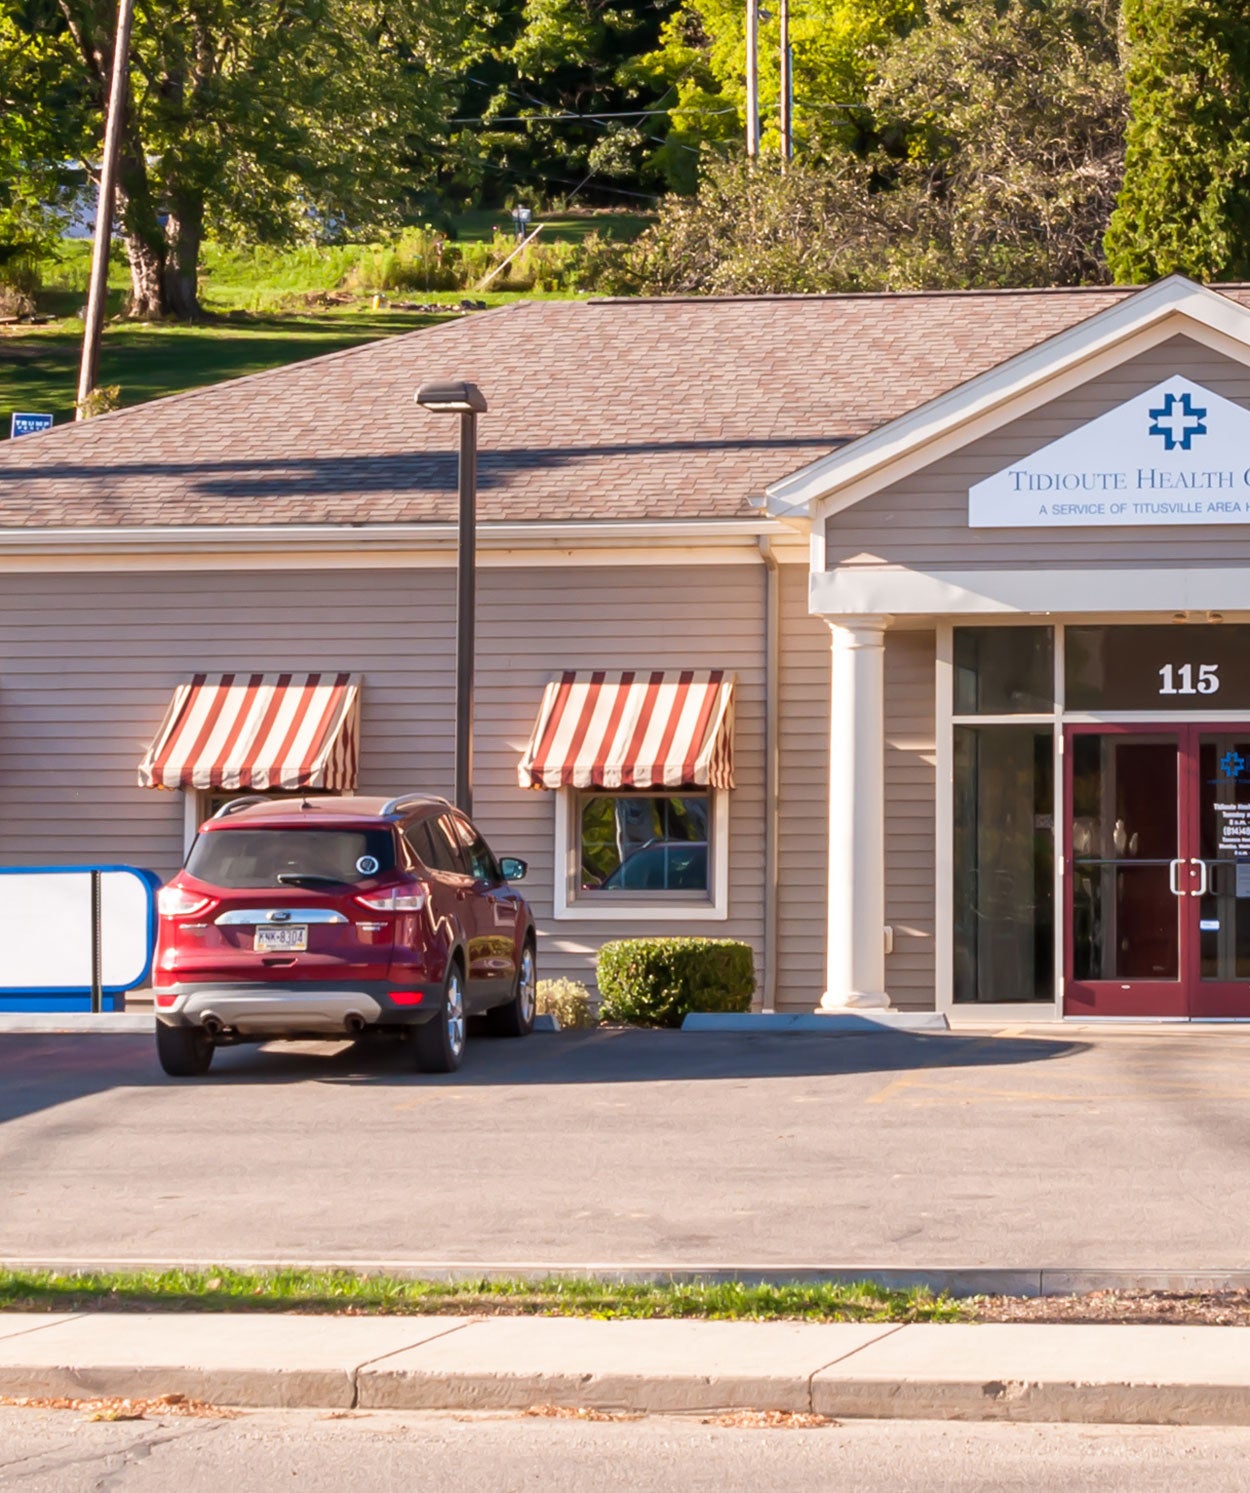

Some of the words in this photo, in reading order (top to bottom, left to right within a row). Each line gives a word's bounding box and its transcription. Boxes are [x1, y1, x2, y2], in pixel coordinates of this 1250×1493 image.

[1008, 470, 1127, 491] TIDIOUTE
[1136, 468, 1234, 490] HEALTH
[1038, 504, 1048, 515] A
[1051, 503, 1105, 515] SERVICE
[1109, 502, 1127, 514] OF
[1133, 502, 1203, 514] TITUSVILLE
[1206, 501, 1241, 513] AREA
[1158, 663, 1220, 695] 115
